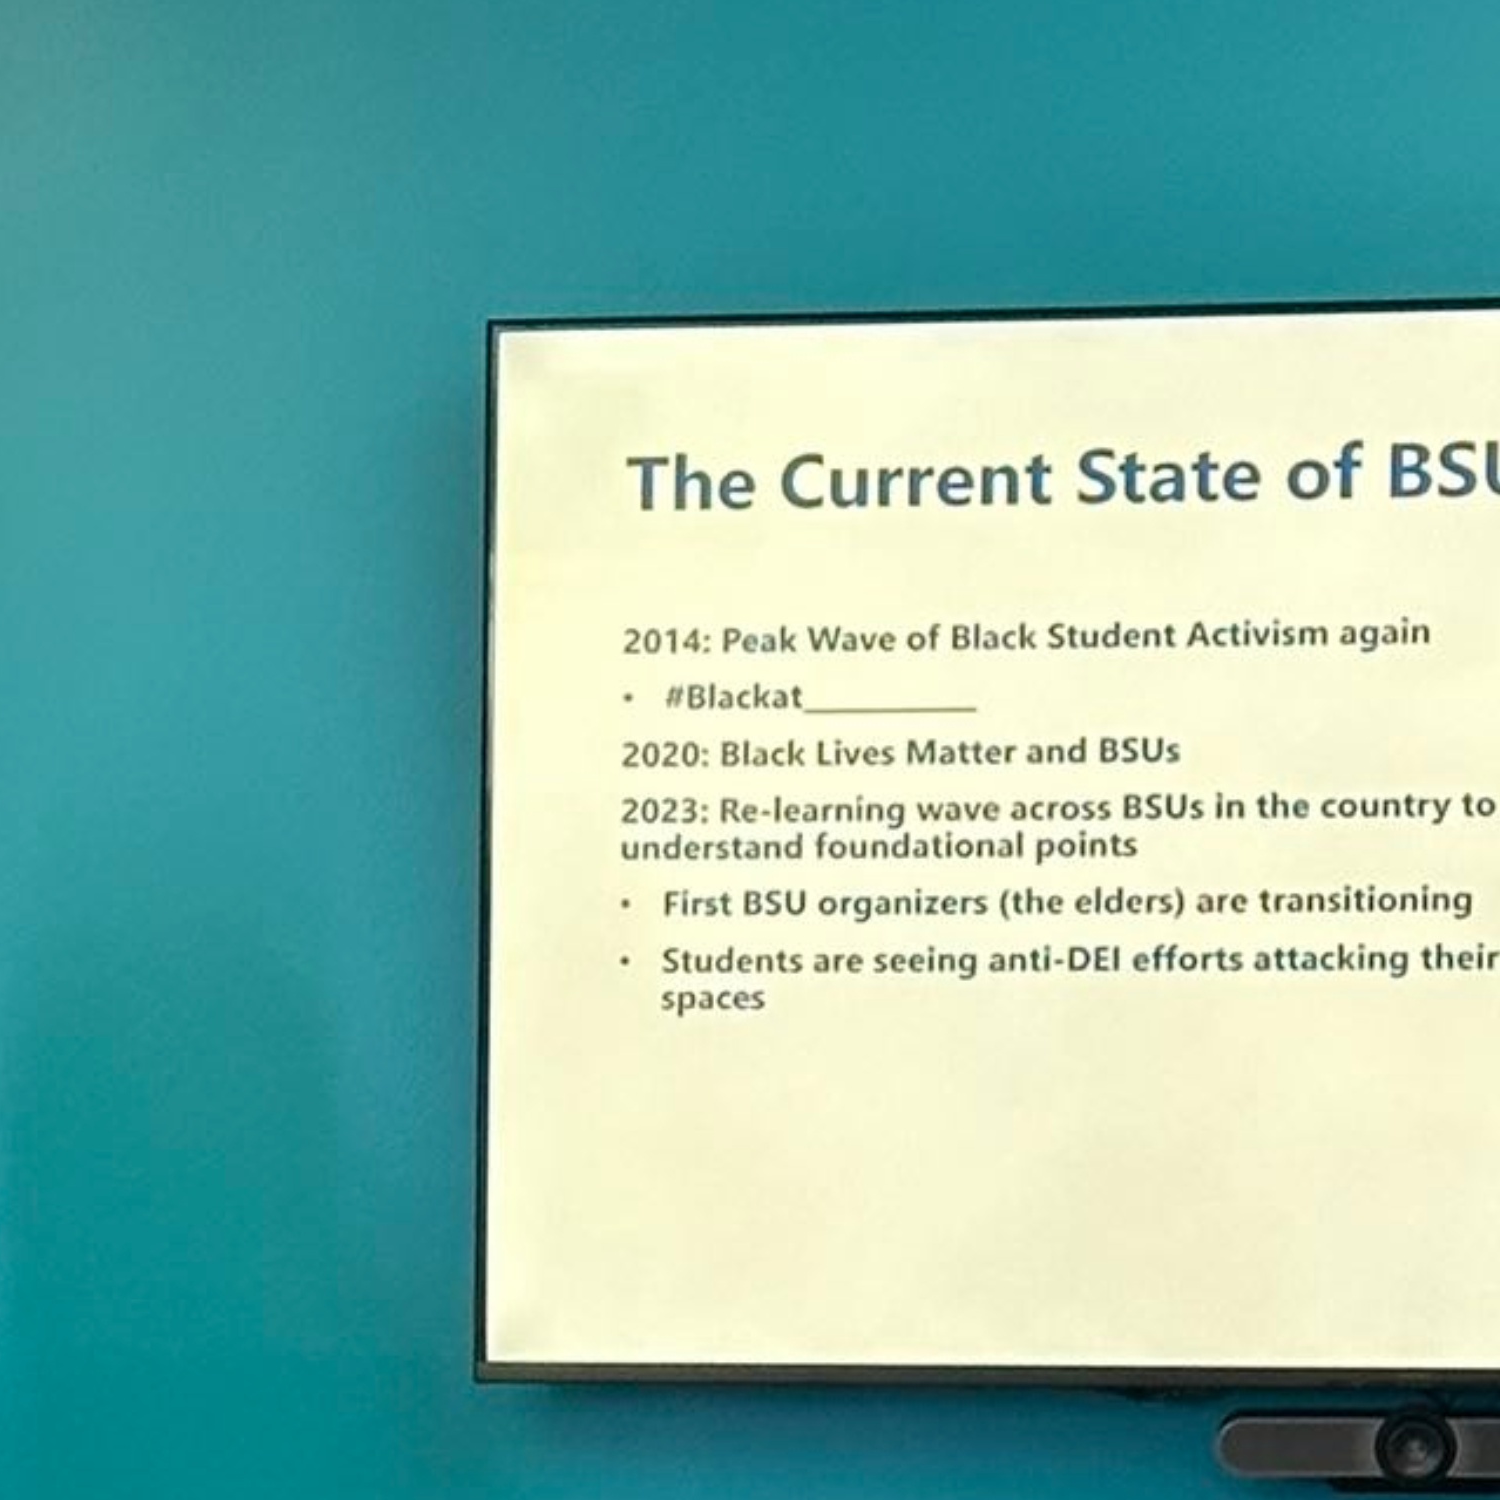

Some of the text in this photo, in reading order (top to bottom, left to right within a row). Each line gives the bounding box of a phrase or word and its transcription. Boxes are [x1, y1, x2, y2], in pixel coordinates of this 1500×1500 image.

[625, 452, 756, 512] The
[780, 452, 1053, 510] Current
[1077, 447, 1262, 505] State
[1286, 439, 1364, 501] of
[623, 616, 1430, 655] 2014: Peak Wave of Black Student Activism again
[622, 736, 1181, 768] 2020: Black Lives Matter and BSUs
[621, 791, 1497, 830] 2023: Re-learning wave across BSUs in the country to
[621, 829, 1138, 866] understand foundational points
[664, 883, 1473, 924] First BSU organizers (the elders) are transitioning
[662, 942, 1500, 981] Students are seeing anti-DEI efforts attacking their
[661, 990, 766, 1018] spaces
